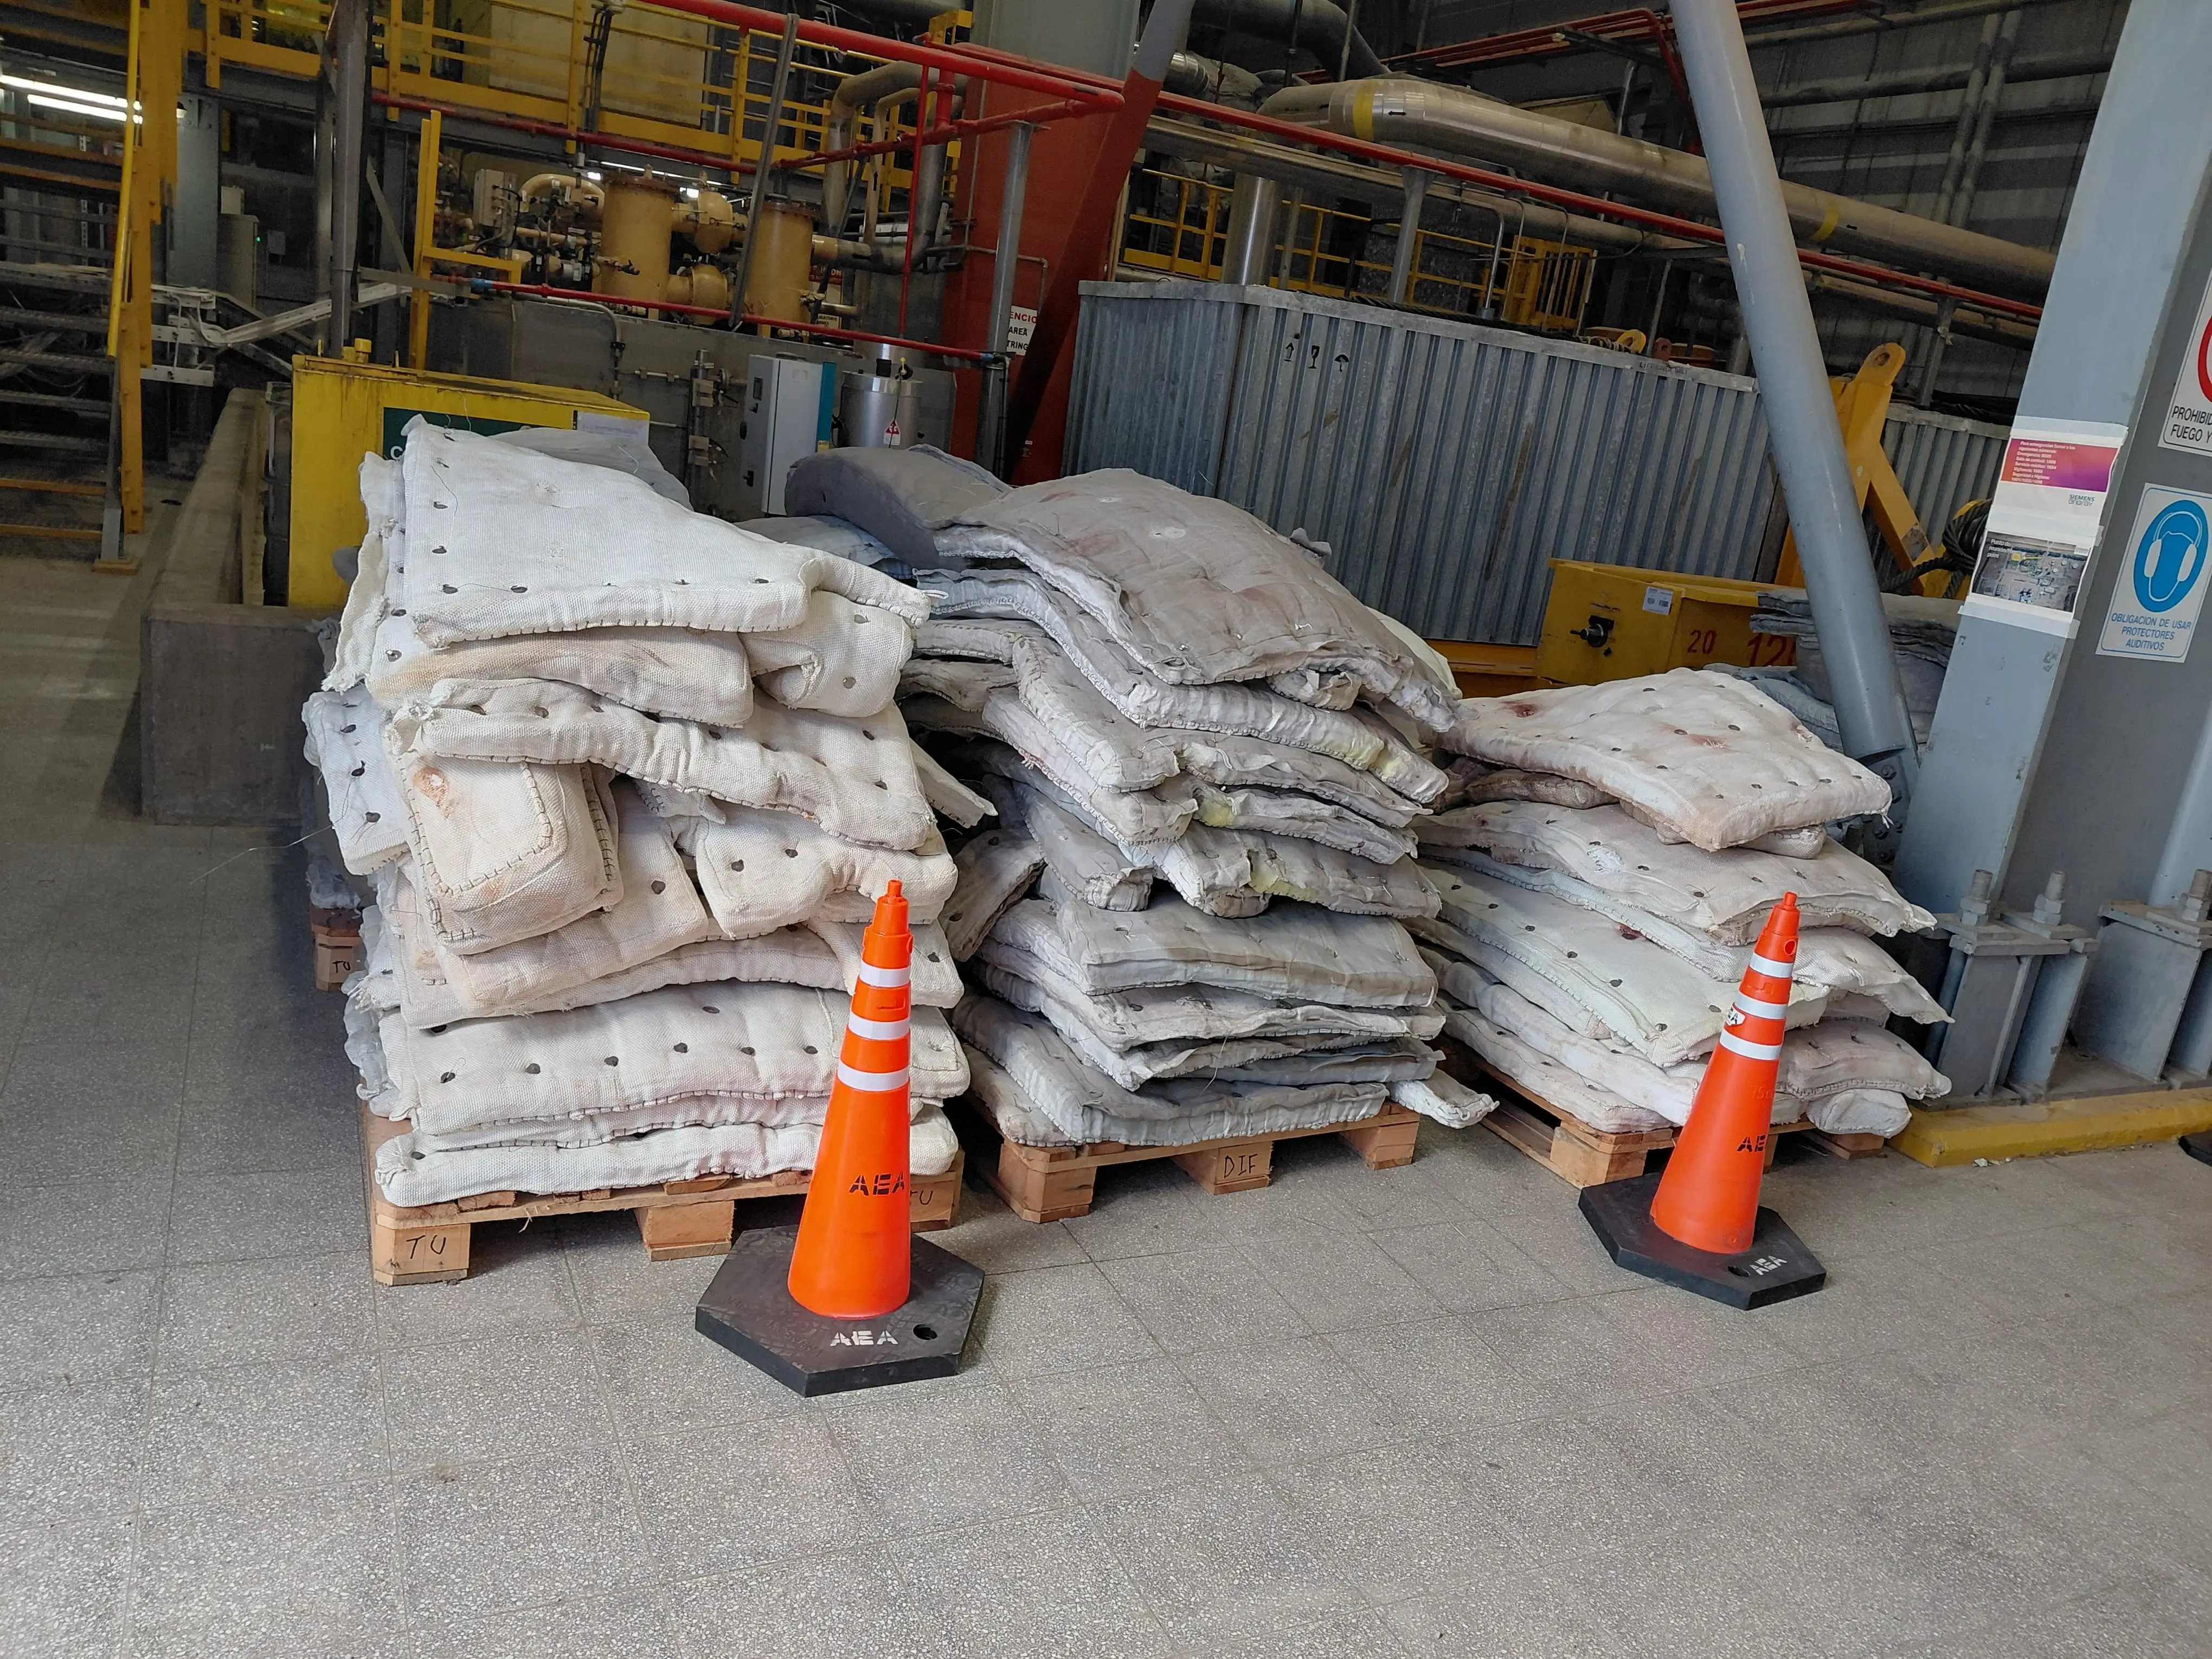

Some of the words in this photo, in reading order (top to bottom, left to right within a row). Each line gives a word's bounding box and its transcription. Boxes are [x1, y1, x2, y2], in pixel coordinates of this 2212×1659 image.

[1008, 326, 1027, 336] AREA
[2171, 424, 2202, 441] FUEGO
[2112, 613, 2157, 626] OBLIGACION
[2159, 618, 2170, 627] DE
[2172, 620, 2191, 629] USAR
[1687, 629, 1717, 654] 20
[2121, 626, 2175, 640] PROTECTORES
[2125, 639, 2165, 651] AUDITIVOS
[332, 960, 351, 973] TU
[1224, 1154, 1258, 1178] DIF
[848, 1171, 905, 1196] AEA
[406, 1234, 446, 1259] TU
[1749, 1255, 1787, 1275] AEA
[830, 1330, 898, 1347] AEA
